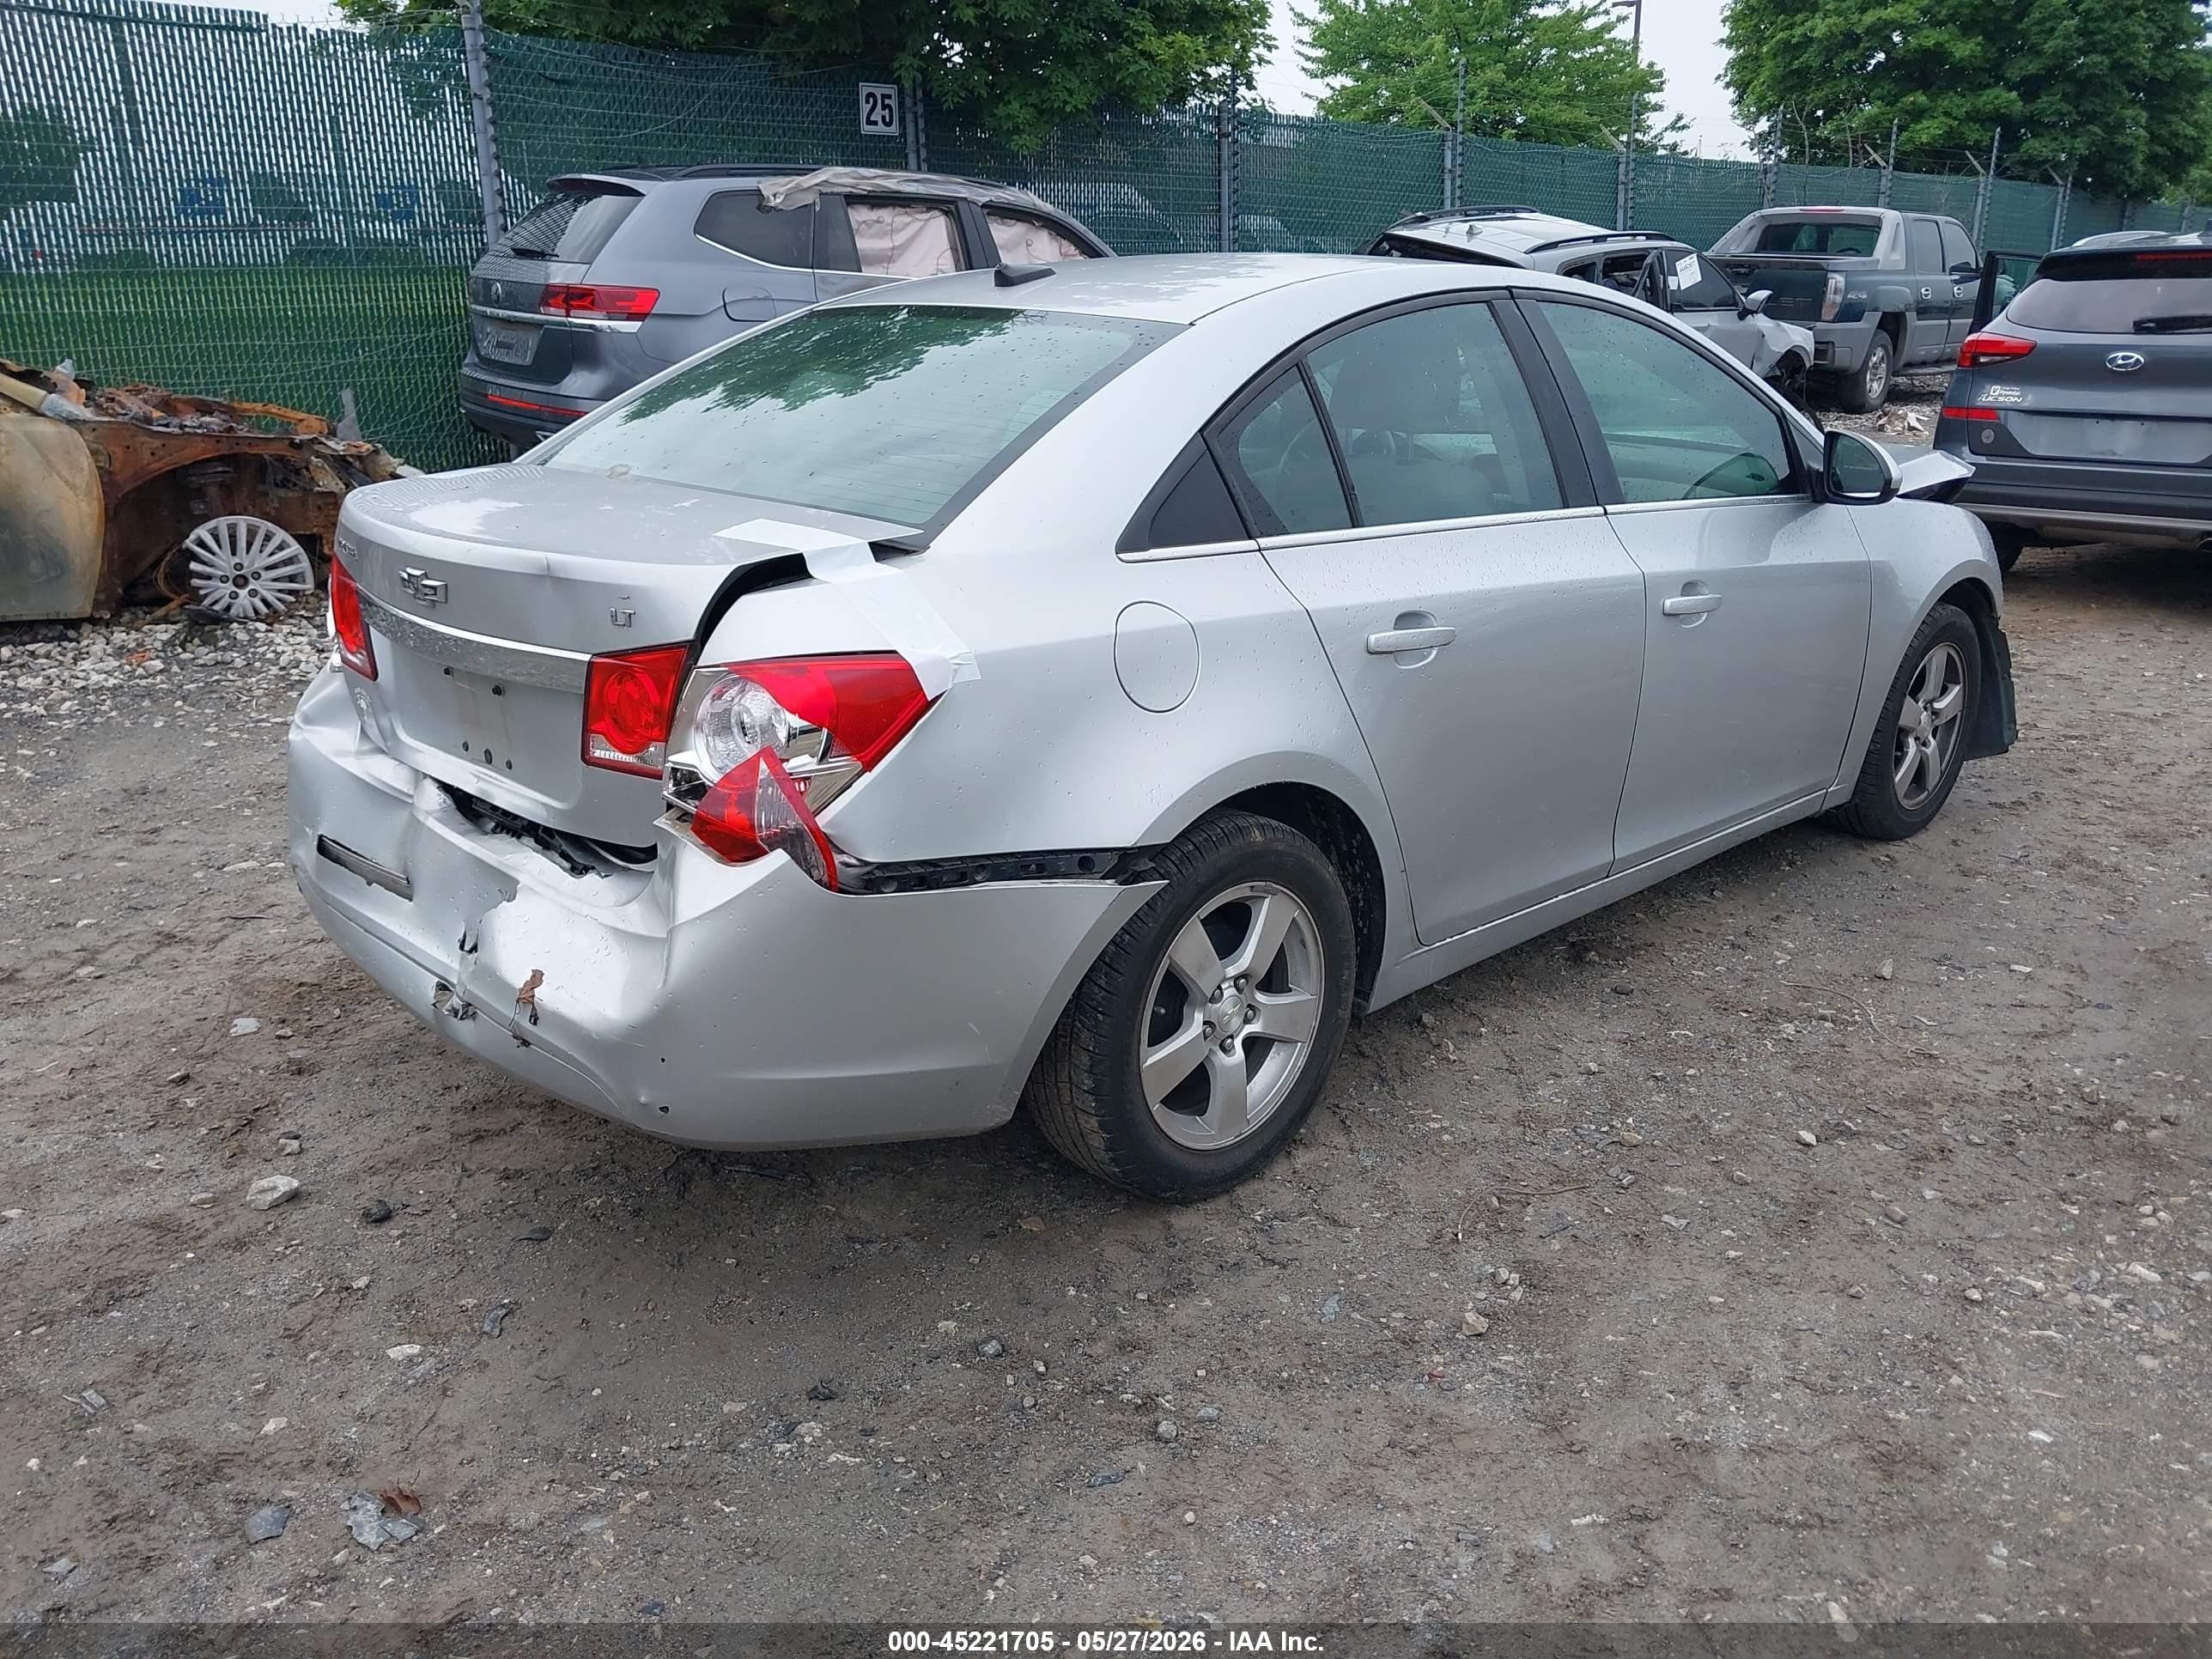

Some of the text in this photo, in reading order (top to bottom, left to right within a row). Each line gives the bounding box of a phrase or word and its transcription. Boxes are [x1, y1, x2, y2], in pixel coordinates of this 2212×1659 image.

[865, 92, 894, 127] 25
[1977, 393, 2024, 403] TUCSON
[610, 607, 636, 627] LT
